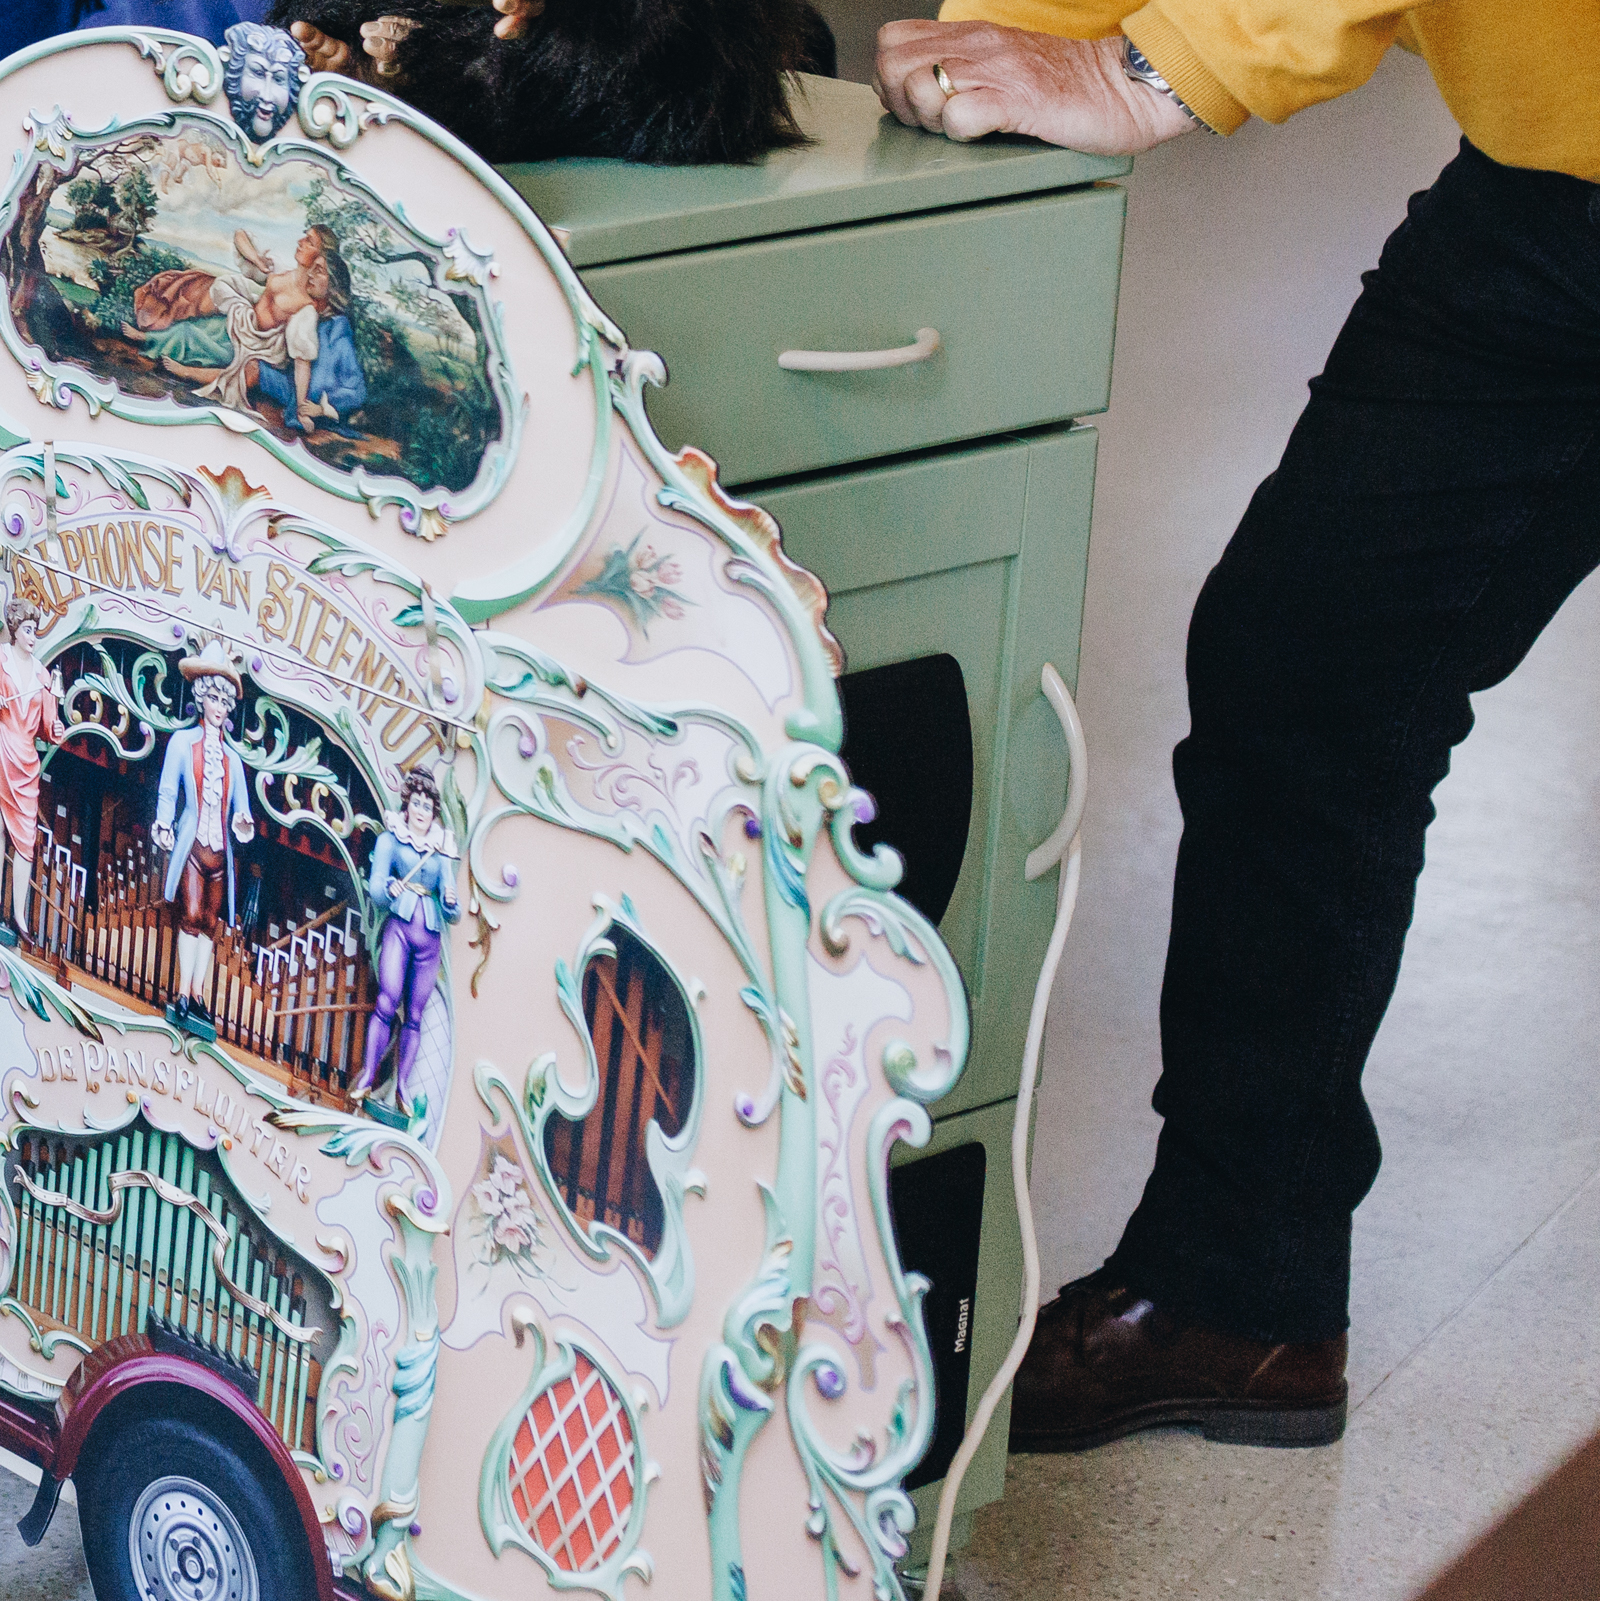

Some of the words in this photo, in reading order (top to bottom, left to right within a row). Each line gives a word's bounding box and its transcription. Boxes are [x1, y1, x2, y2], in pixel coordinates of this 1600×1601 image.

[11, 519, 184, 638] ALPHONSE
[193, 544, 252, 614] VAN
[257, 560, 447, 775] STEENPUT
[35, 1043, 78, 1083] DE
[953, 1296, 970, 1354] Magnat
